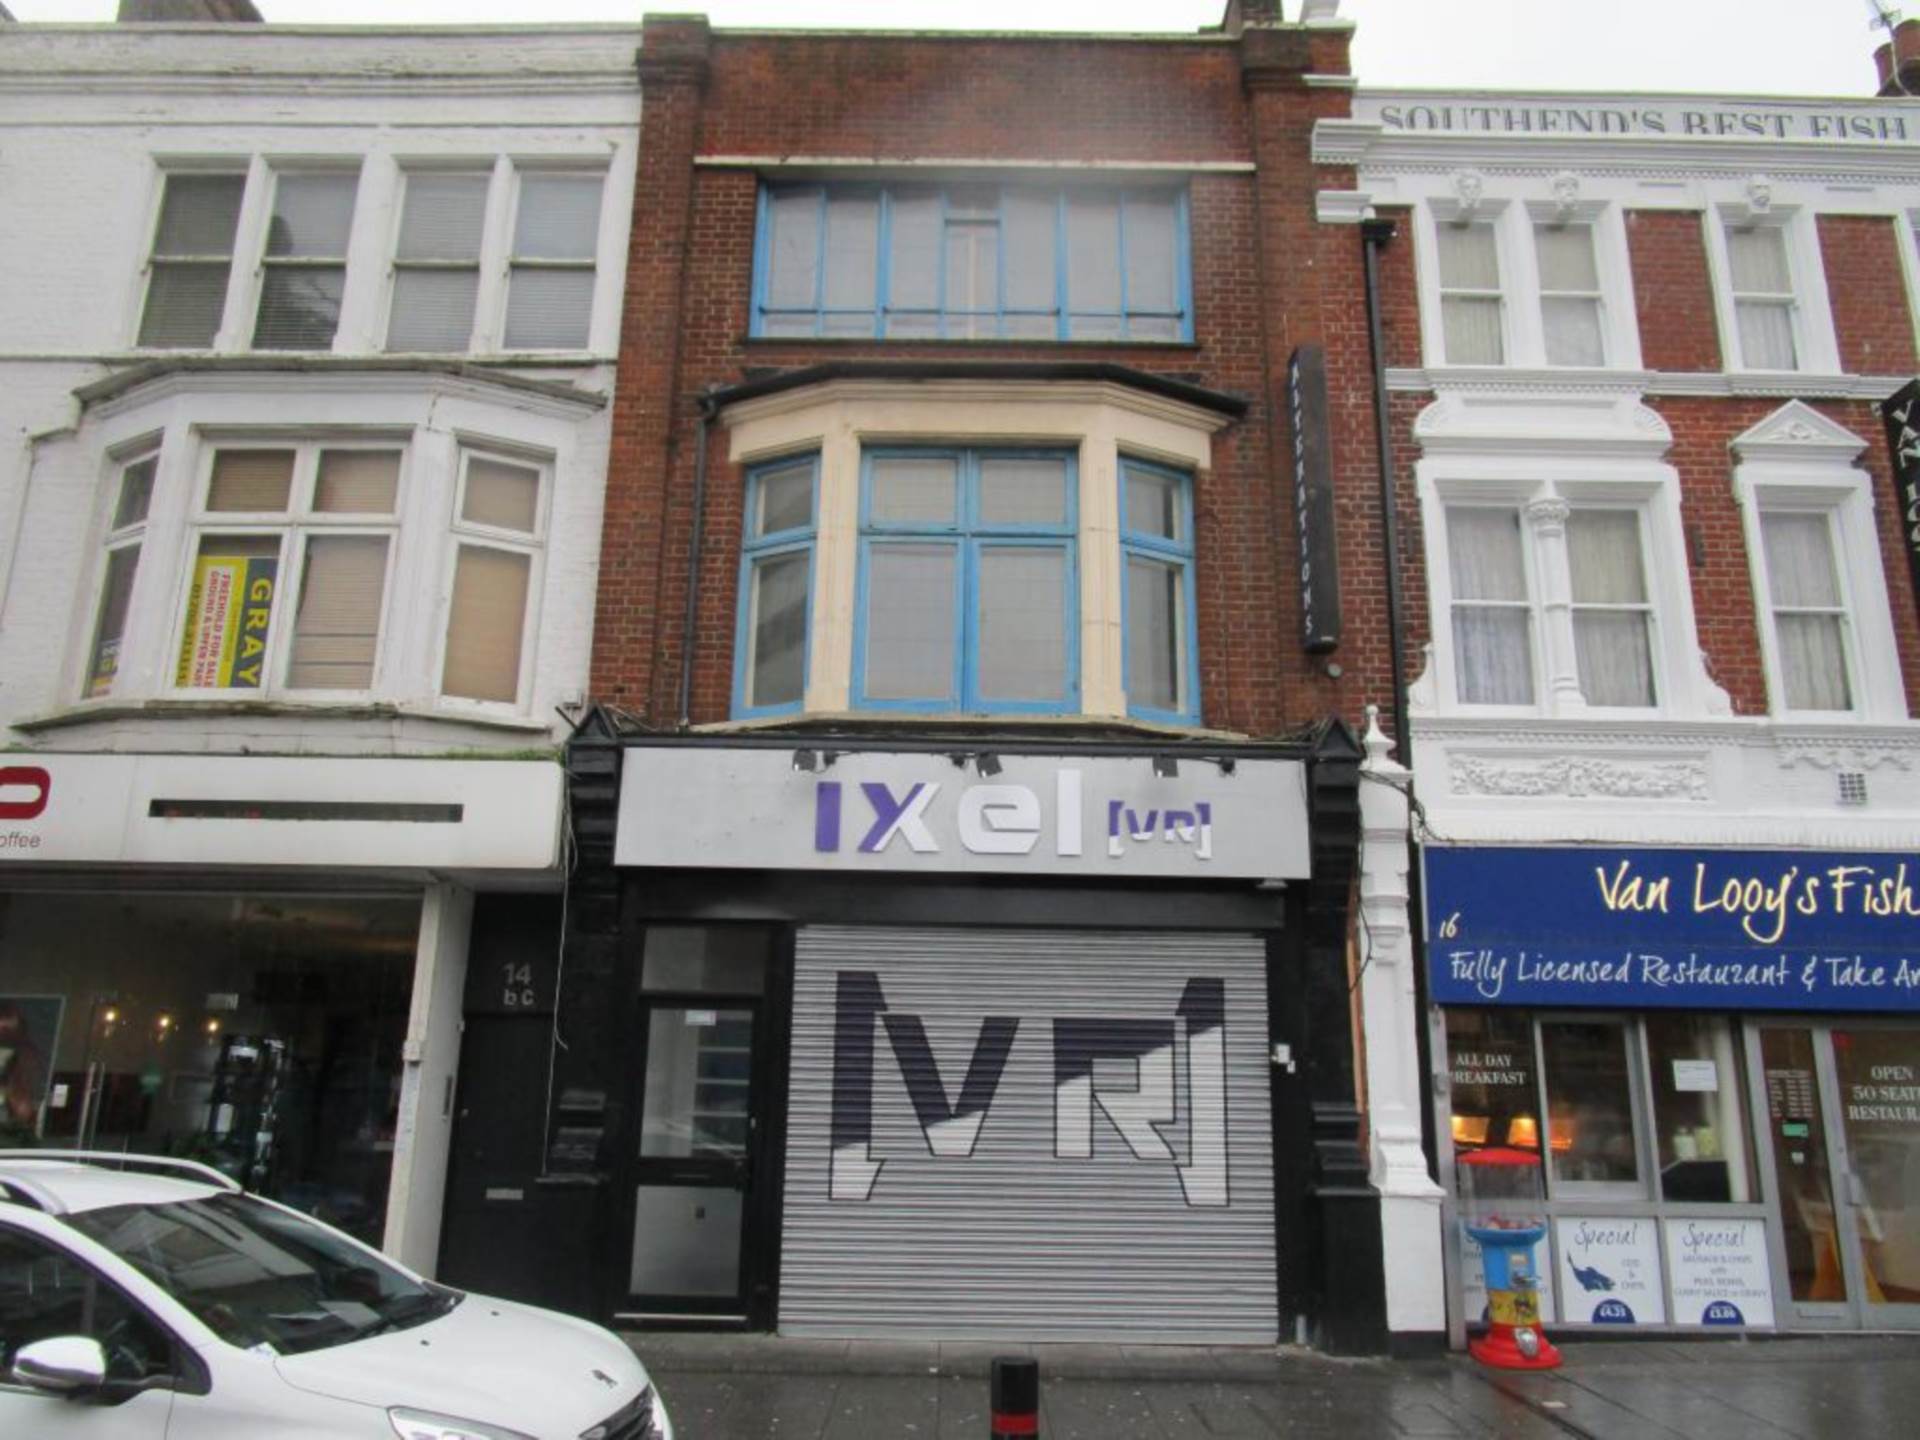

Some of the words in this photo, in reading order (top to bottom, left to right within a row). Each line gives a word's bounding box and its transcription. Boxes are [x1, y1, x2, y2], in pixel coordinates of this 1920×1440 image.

[1380, 105, 1665, 133] SOUTHEND'S
[1683, 111, 1793, 138] BEST
[1809, 115, 1907, 140] FISH
[238, 578, 273, 685] GRAY
[1596, 860, 1670, 913] Van
[1694, 863, 1820, 943] Looy's
[1827, 864, 1920, 915] Fish
[1439, 912, 1461, 939] 16
[504, 962, 531, 985] 14
[1448, 950, 1506, 998] Fully
[1517, 951, 1632, 983] Licensed
[1639, 953, 1790, 987] Restaurant
[1802, 956, 1817, 991] &
[1824, 956, 1886, 987] Take
[1456, 1053, 1482, 1066] ALL
[1485, 1053, 1512, 1067] DAY
[1871, 1065, 1913, 1080] OPEN
[1853, 1086, 1876, 1100] 50
[1574, 1221, 1637, 1253] Special
[1682, 1223, 1746, 1255] Special
